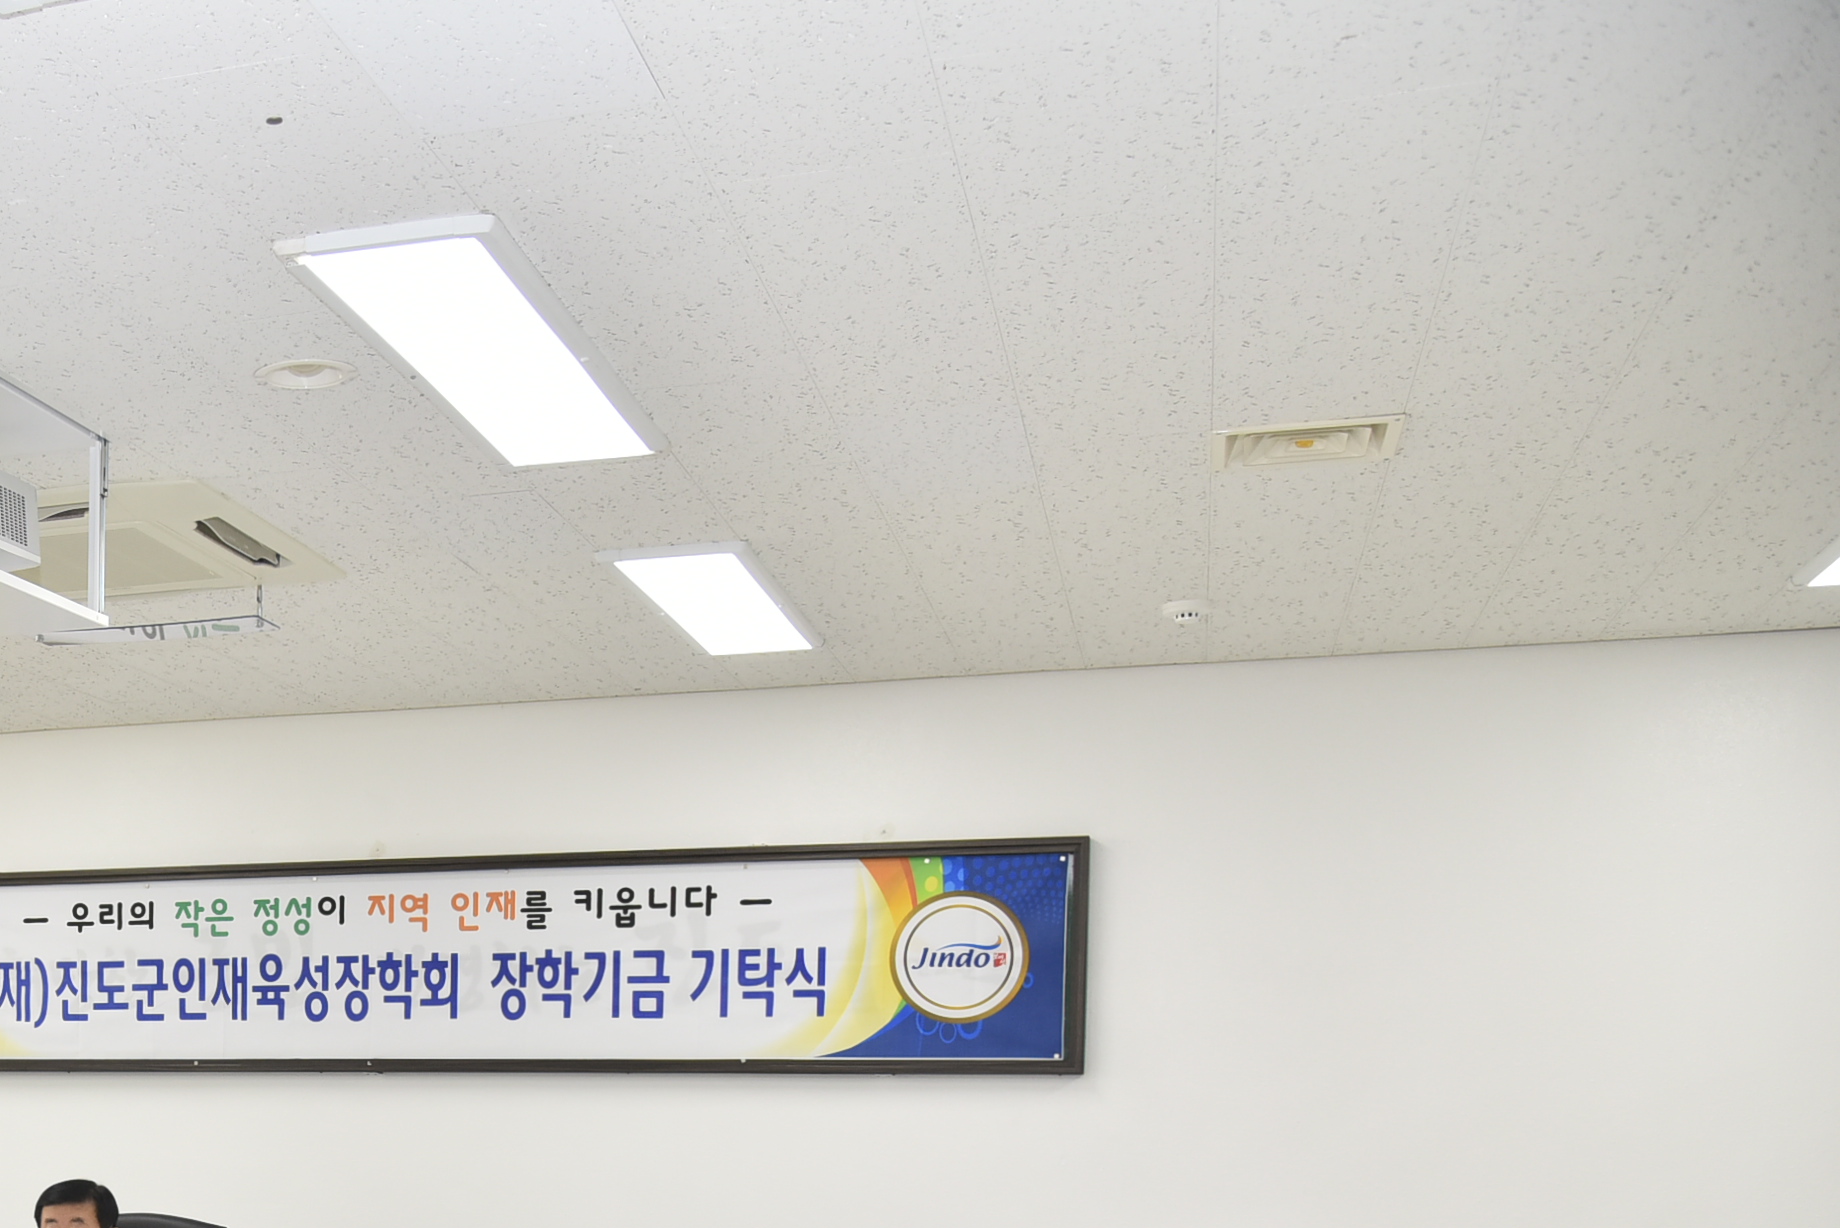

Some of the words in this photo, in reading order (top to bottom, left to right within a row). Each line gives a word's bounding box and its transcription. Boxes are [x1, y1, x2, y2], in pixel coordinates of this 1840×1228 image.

[66, 900, 155, 933] 우리의
[174, 898, 234, 938] 작은
[253, 895, 346, 937] 정성이
[367, 892, 430, 932] 지역
[450, 889, 553, 931] 인재를
[573, 885, 718, 928] 키웁니다
[490, 947, 671, 1021] 장학기금
[689, 946, 827, 1018] 기탁식
[911, 947, 991, 970] Jindo
